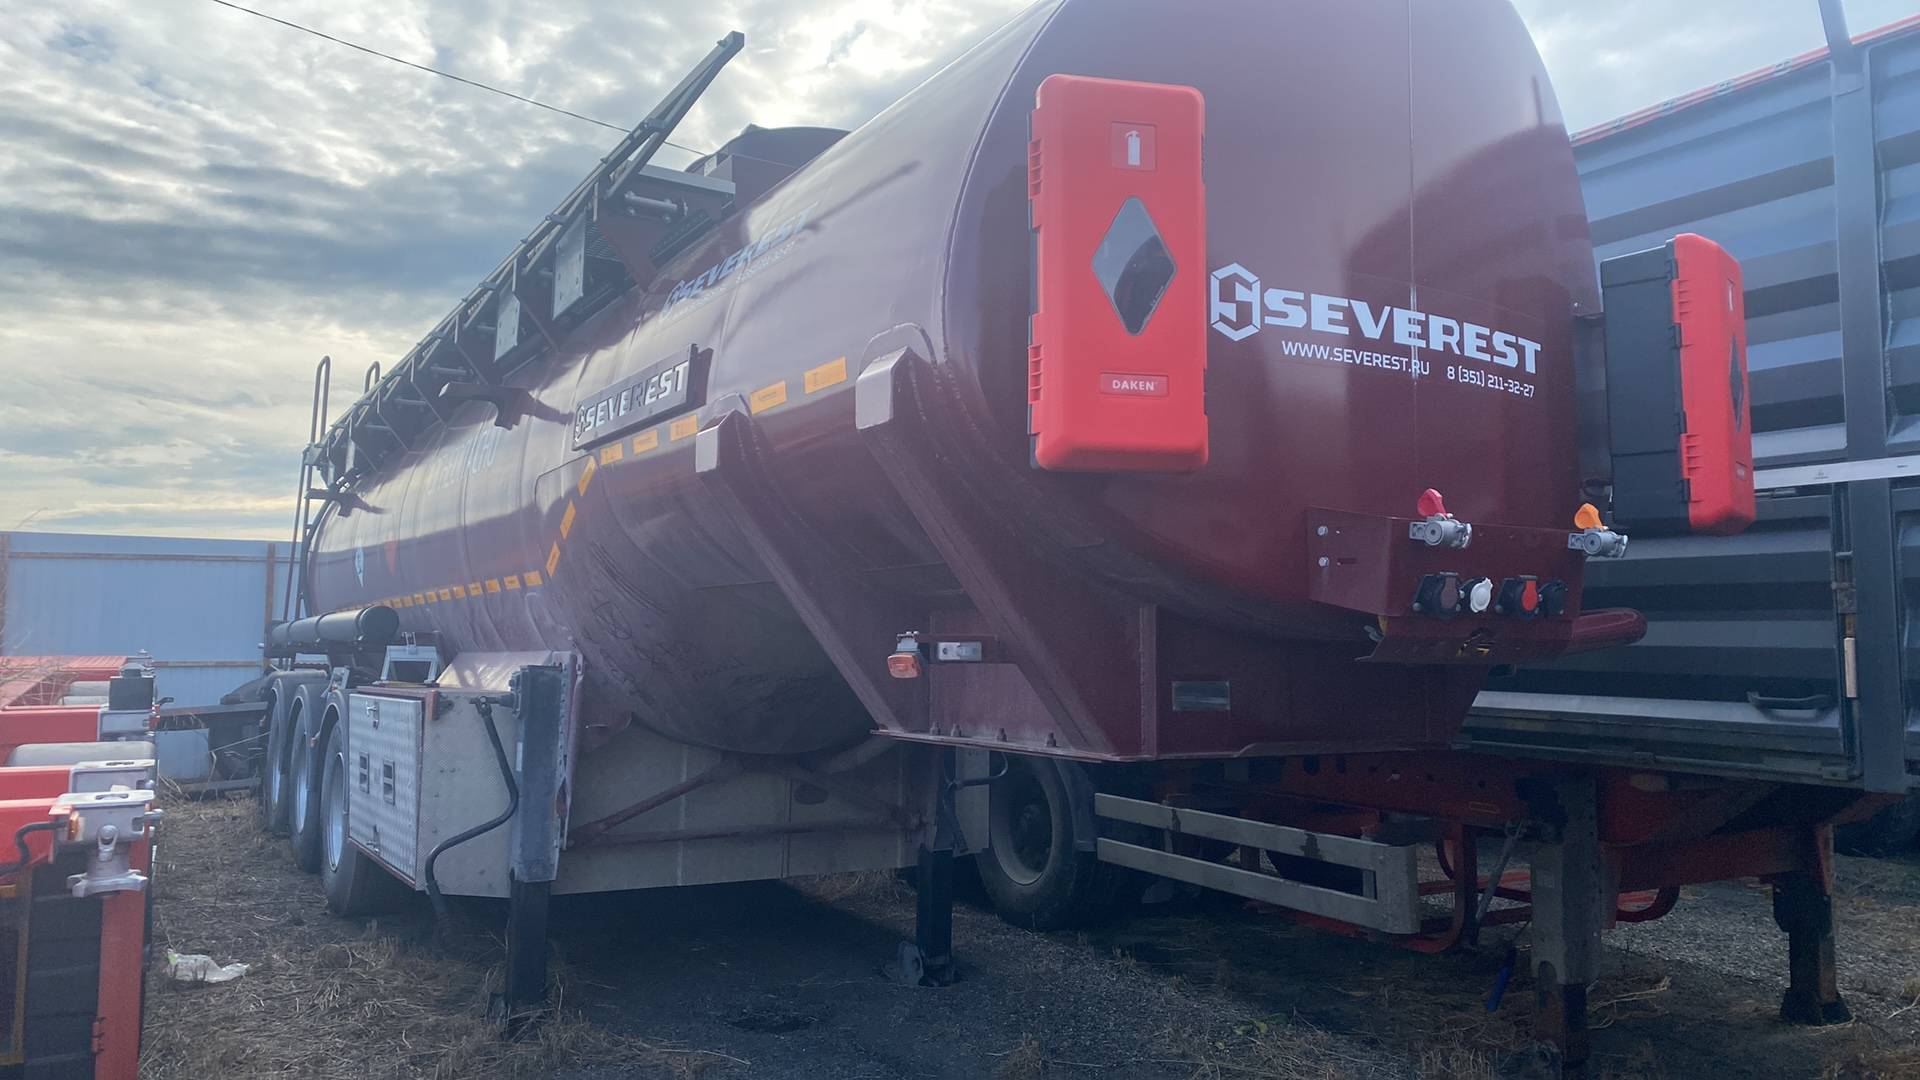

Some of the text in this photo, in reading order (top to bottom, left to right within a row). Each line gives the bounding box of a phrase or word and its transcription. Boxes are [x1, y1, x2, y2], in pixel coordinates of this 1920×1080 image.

[1263, 287, 1542, 375] SEVEREST
[1281, 340, 1430, 376] WWW.SEVEREST.RU
[583, 361, 689, 432] SEVEREST
[1112, 379, 1155, 391] DAKEN
[1446, 365, 1535, 398] 8 (351) 211-32-27
